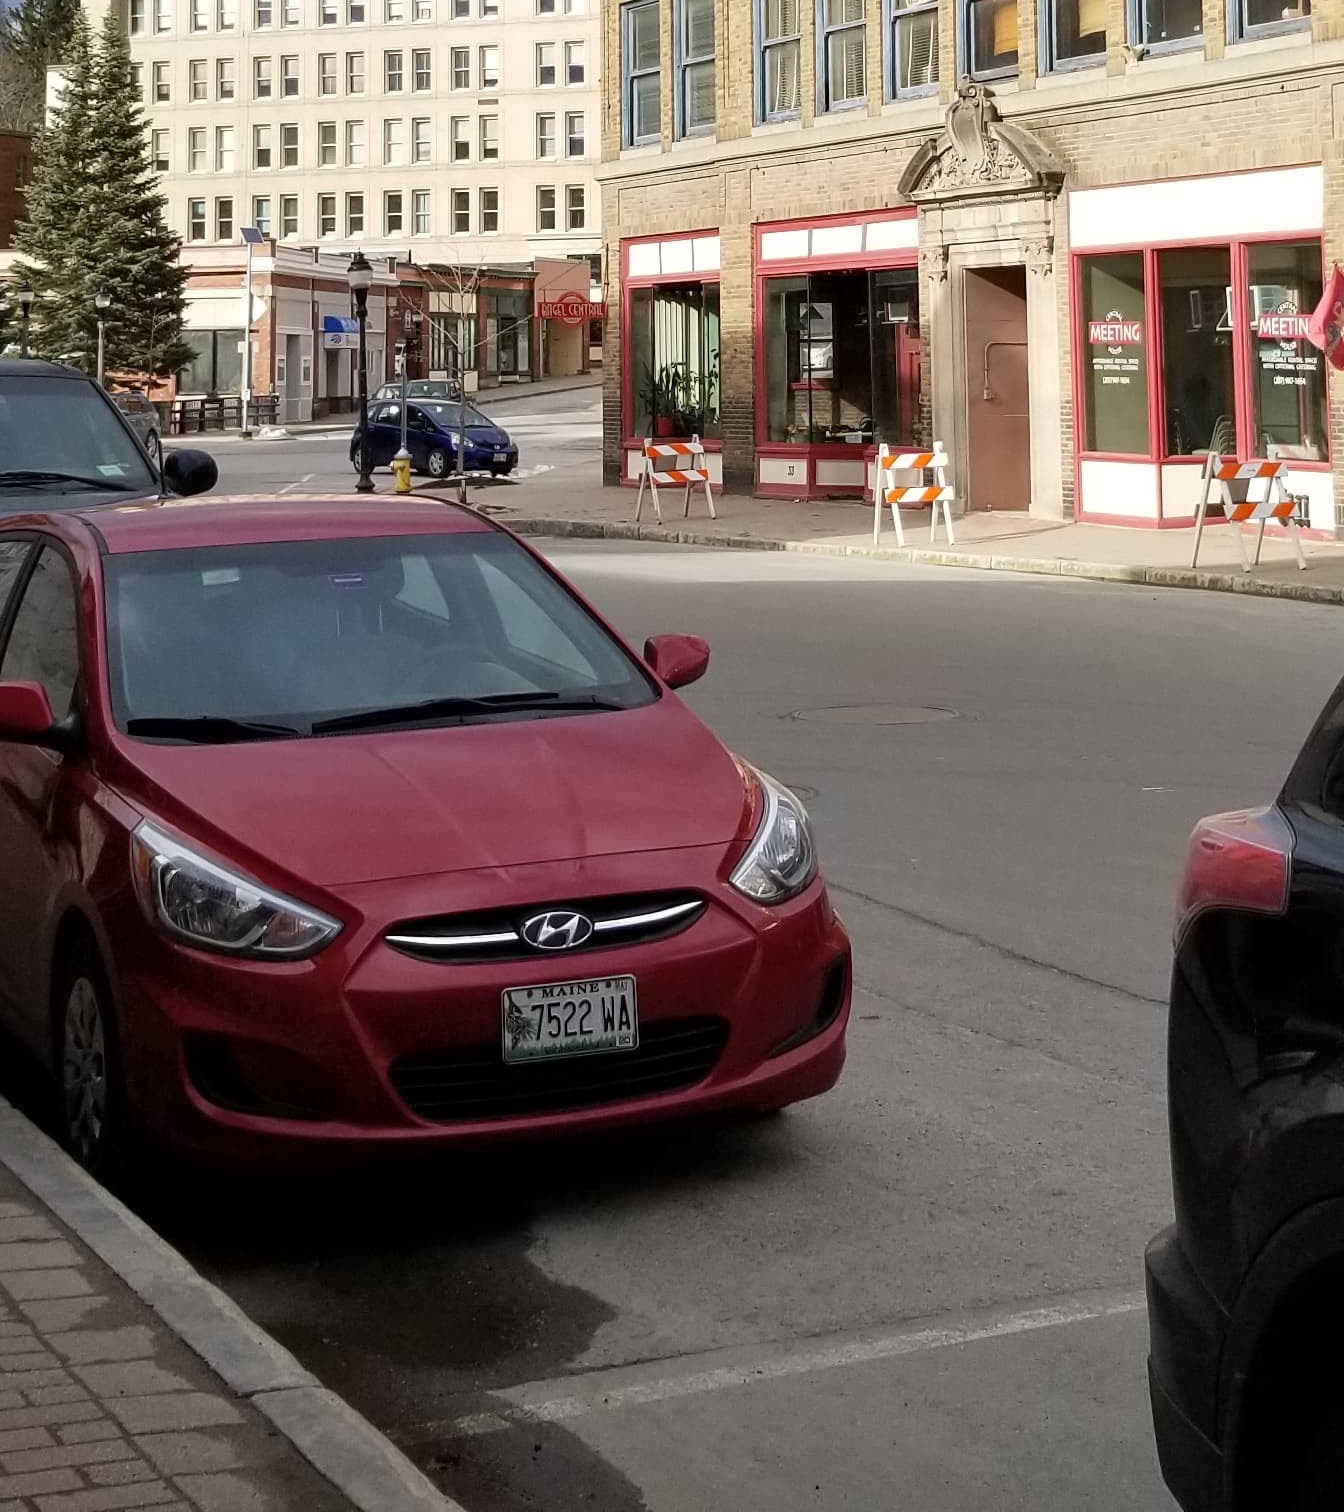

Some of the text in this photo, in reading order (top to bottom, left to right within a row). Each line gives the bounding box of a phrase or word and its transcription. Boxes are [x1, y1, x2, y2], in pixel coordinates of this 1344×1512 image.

[541, 303, 603, 317] BAGEL CENTRAL
[1090, 324, 1140, 342] MEETING
[1258, 317, 1310, 337] MEETIN
[542, 982, 600, 999] MAINE
[531, 994, 632, 1041] 7522 WA
